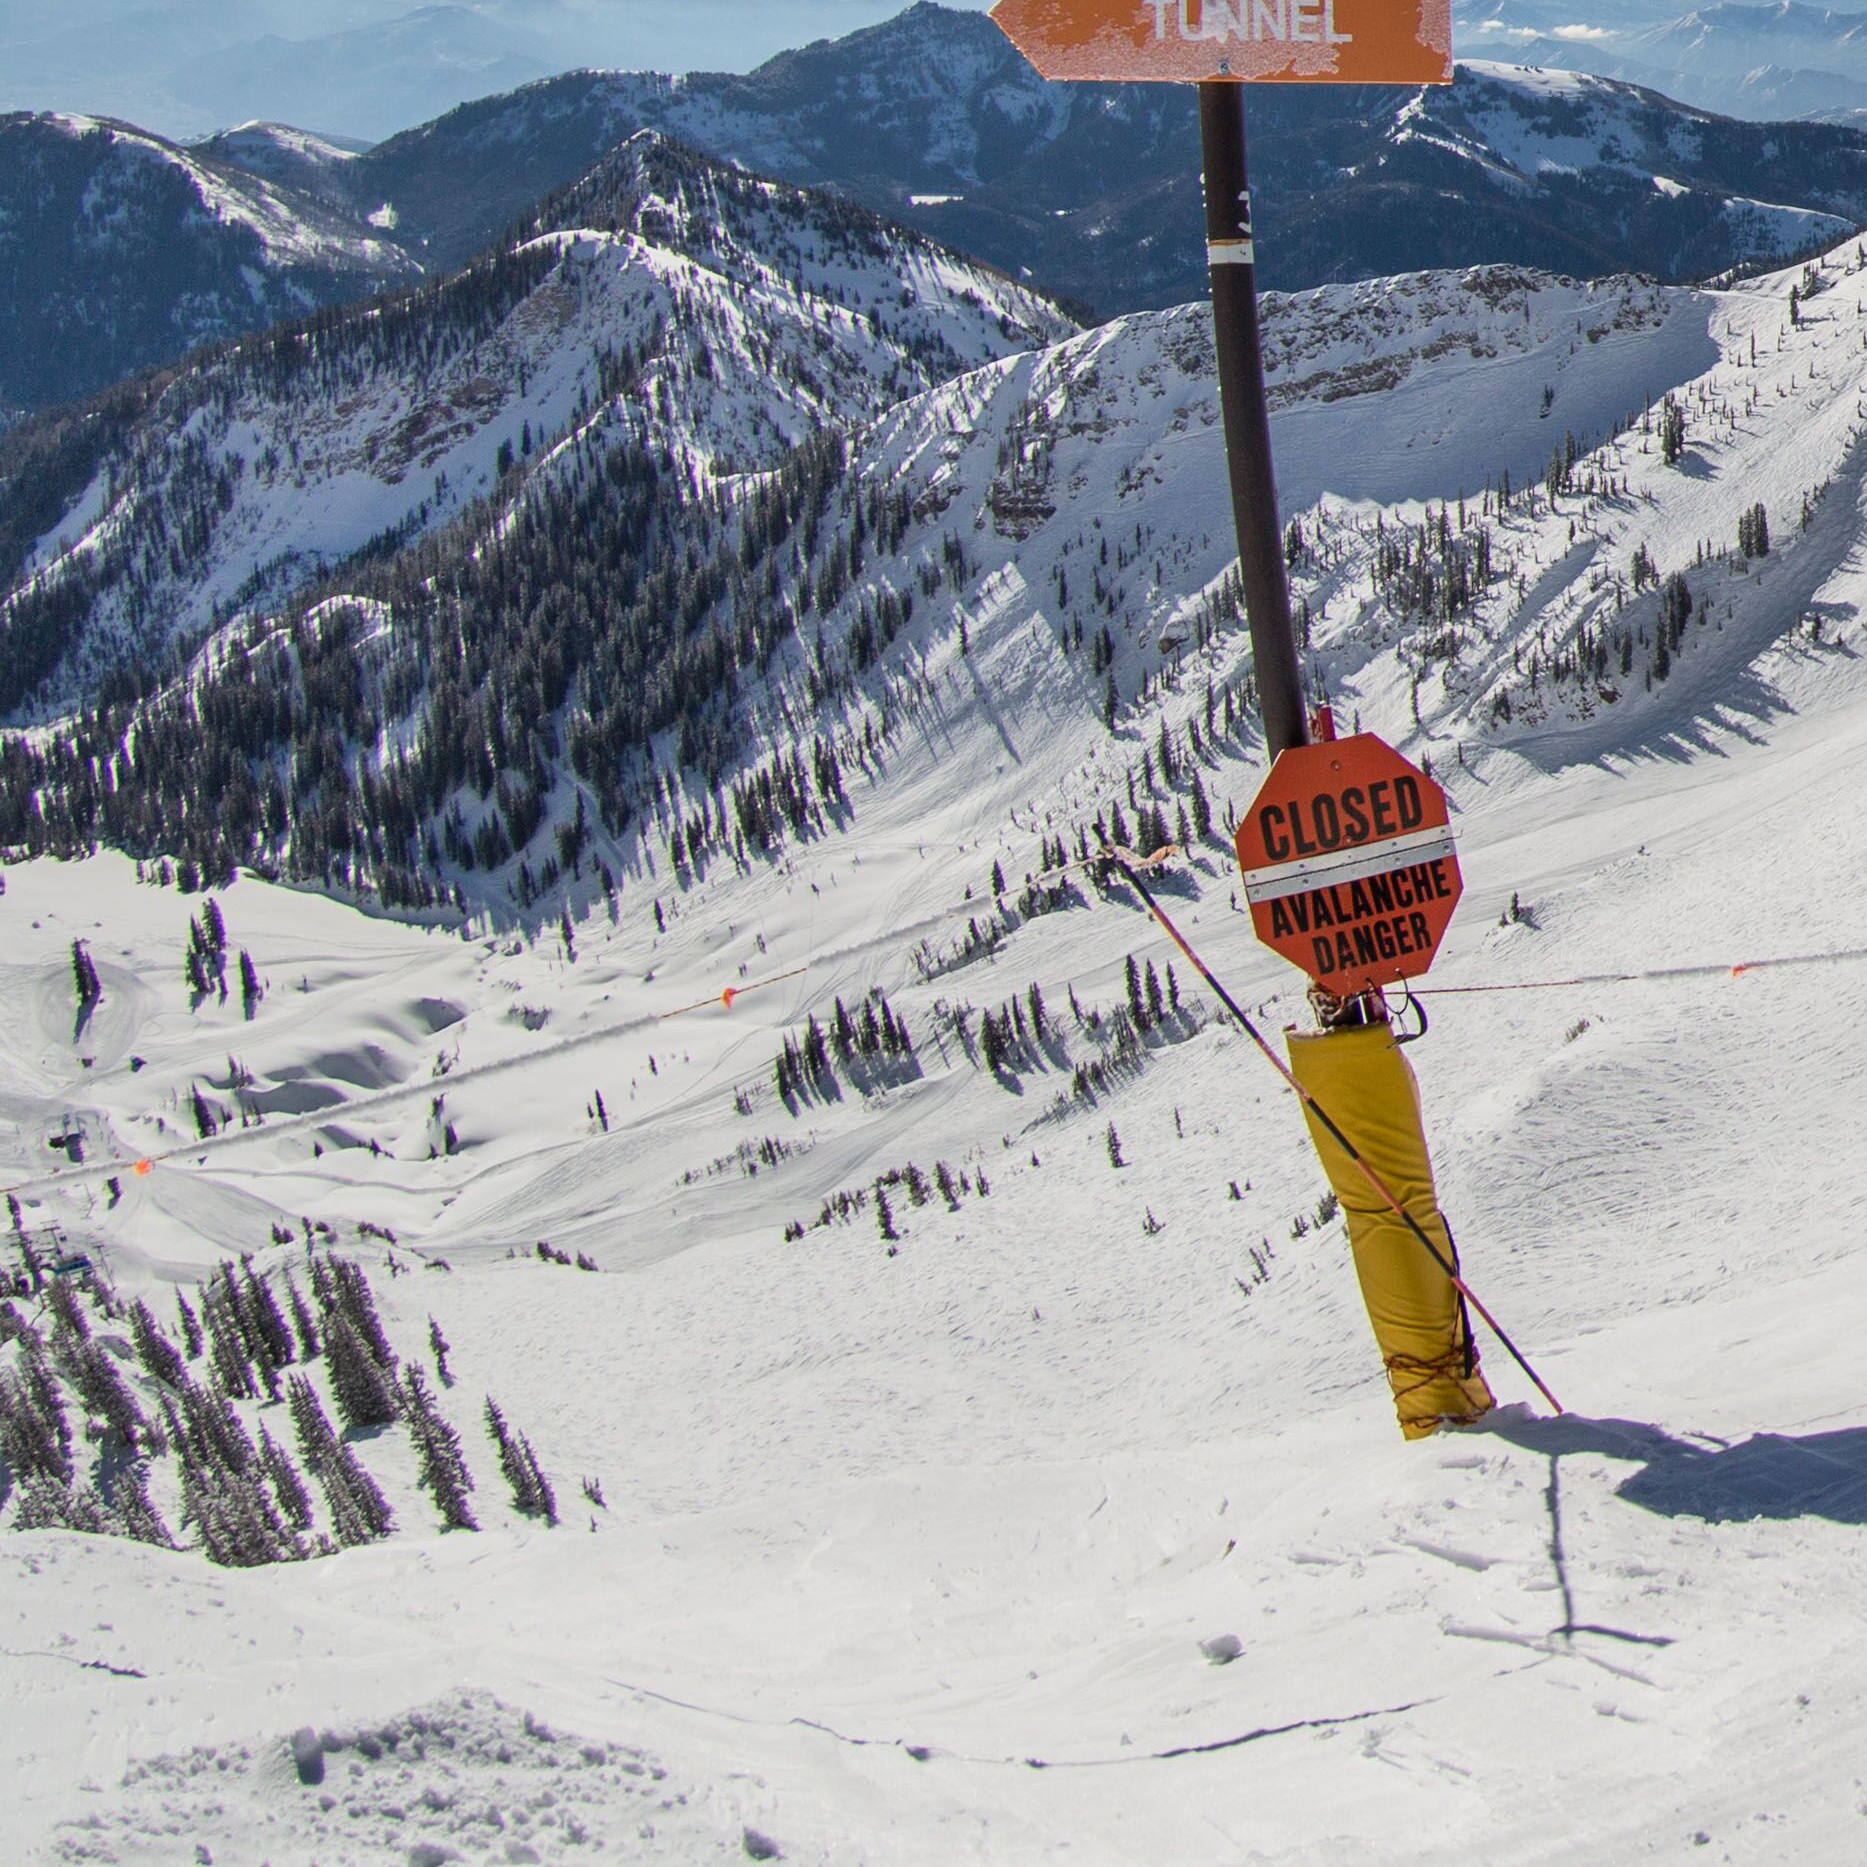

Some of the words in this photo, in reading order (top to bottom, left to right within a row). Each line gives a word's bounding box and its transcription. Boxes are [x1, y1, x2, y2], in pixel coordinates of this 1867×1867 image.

[1259, 775, 1423, 861] CLOSED
[1270, 858, 1451, 939] AVALANCHE
[1311, 911, 1432, 976] DANGER
